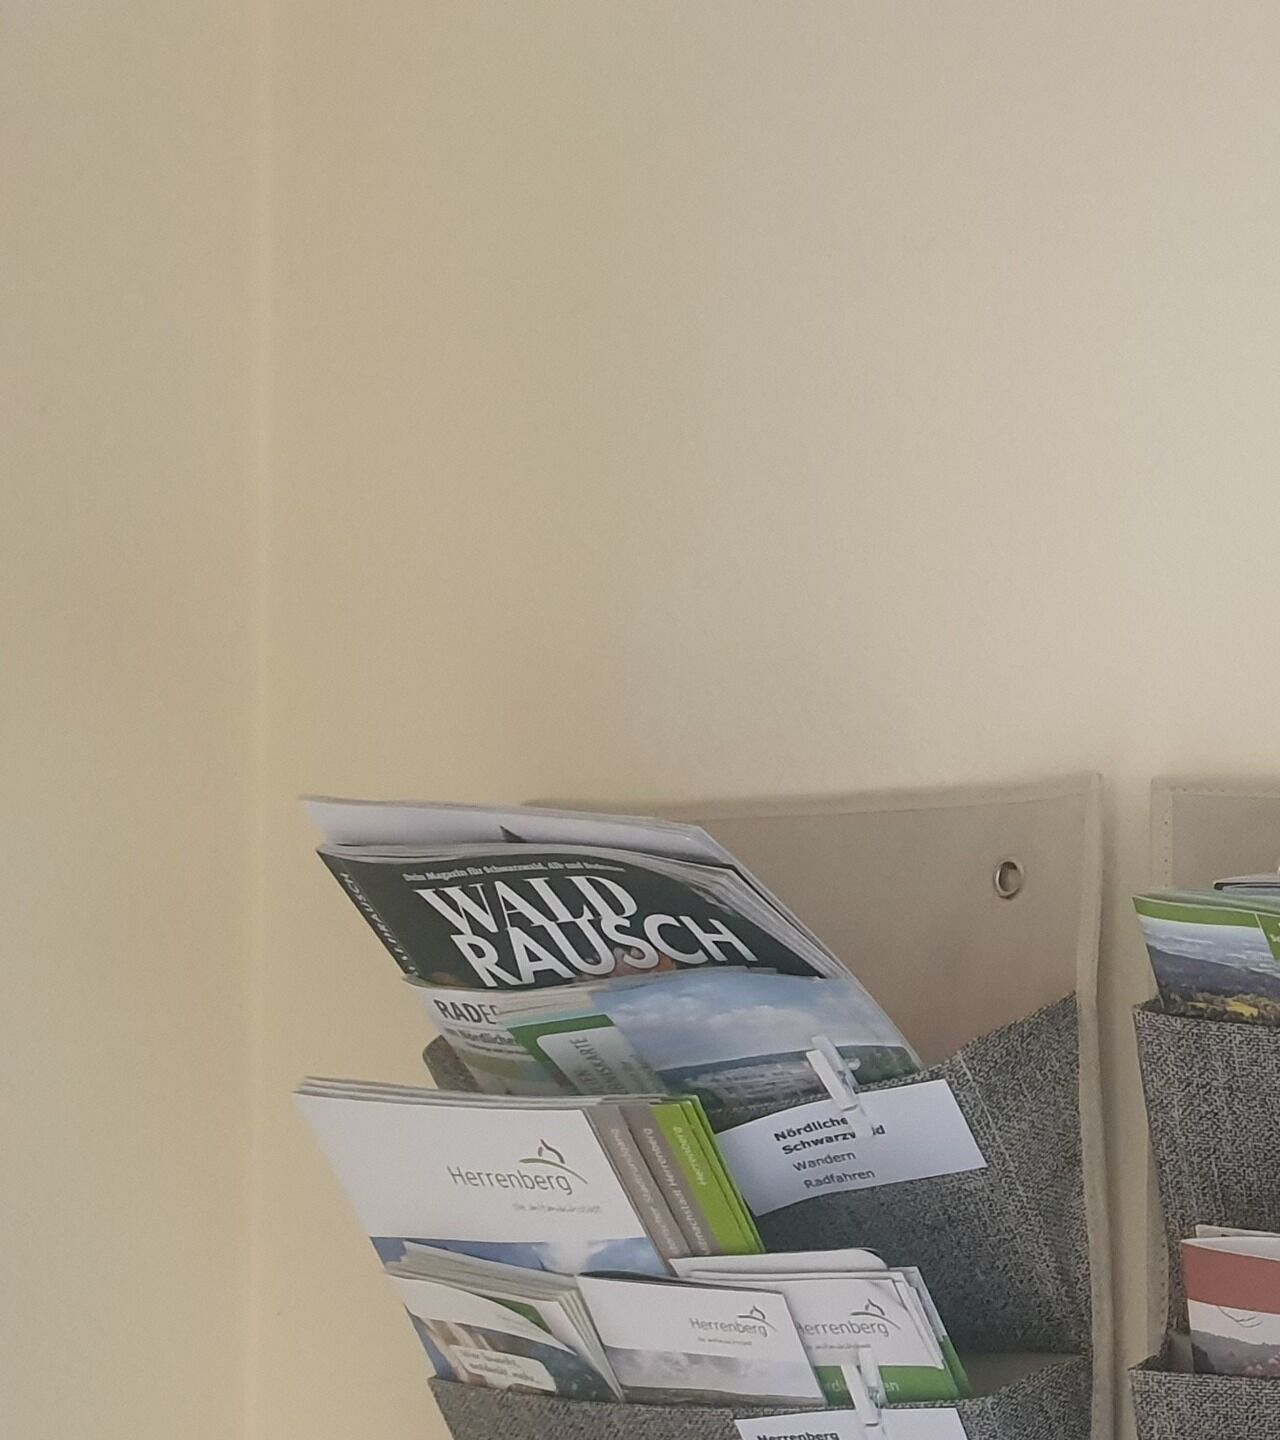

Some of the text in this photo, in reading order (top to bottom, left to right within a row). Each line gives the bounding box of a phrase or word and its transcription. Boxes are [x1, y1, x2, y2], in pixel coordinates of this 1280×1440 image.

[413, 876, 638, 934] WALD
[450, 913, 758, 988] RAUSCH
[792, 1151, 856, 1171] Wandern
[447, 1166, 573, 1195] Herrenberg
[804, 1169, 875, 1189] Radfahren
[690, 1317, 768, 1337] Herrenberg
